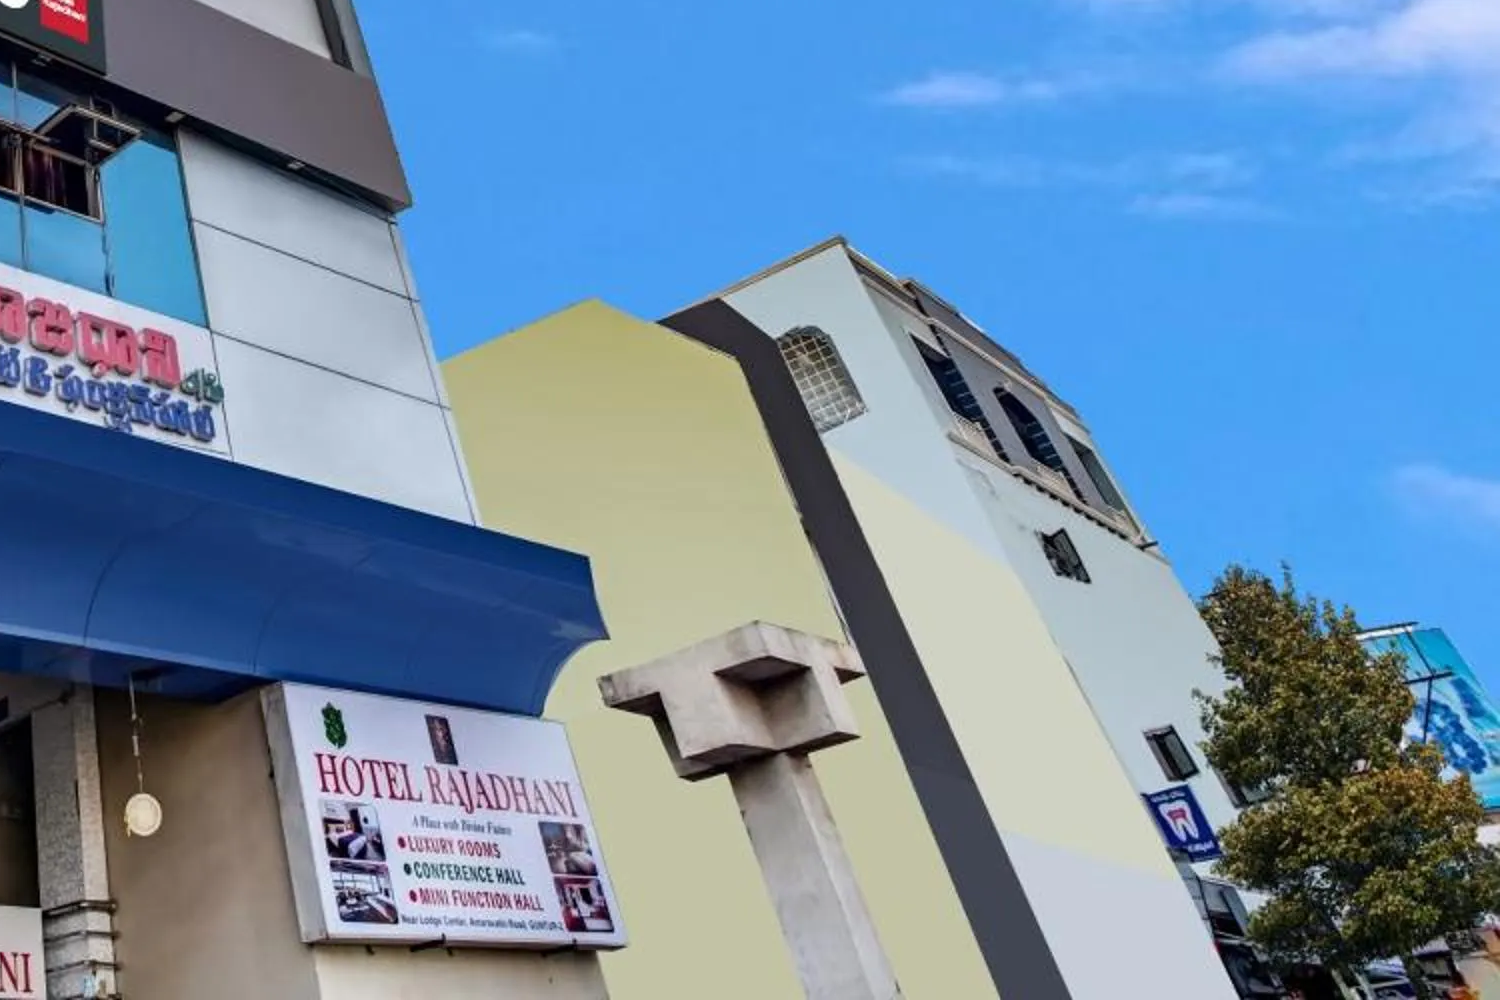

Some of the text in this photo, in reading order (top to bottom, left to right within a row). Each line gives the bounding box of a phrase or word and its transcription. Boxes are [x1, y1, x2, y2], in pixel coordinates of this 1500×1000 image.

[314, 752, 579, 818] HOTEL RAJADHANI
[407, 835, 501, 859] LUXURY ROOMS
[413, 861, 526, 886] CONFERENCE HALL
[418, 887, 545, 912] MINI FUNCTION HALL
